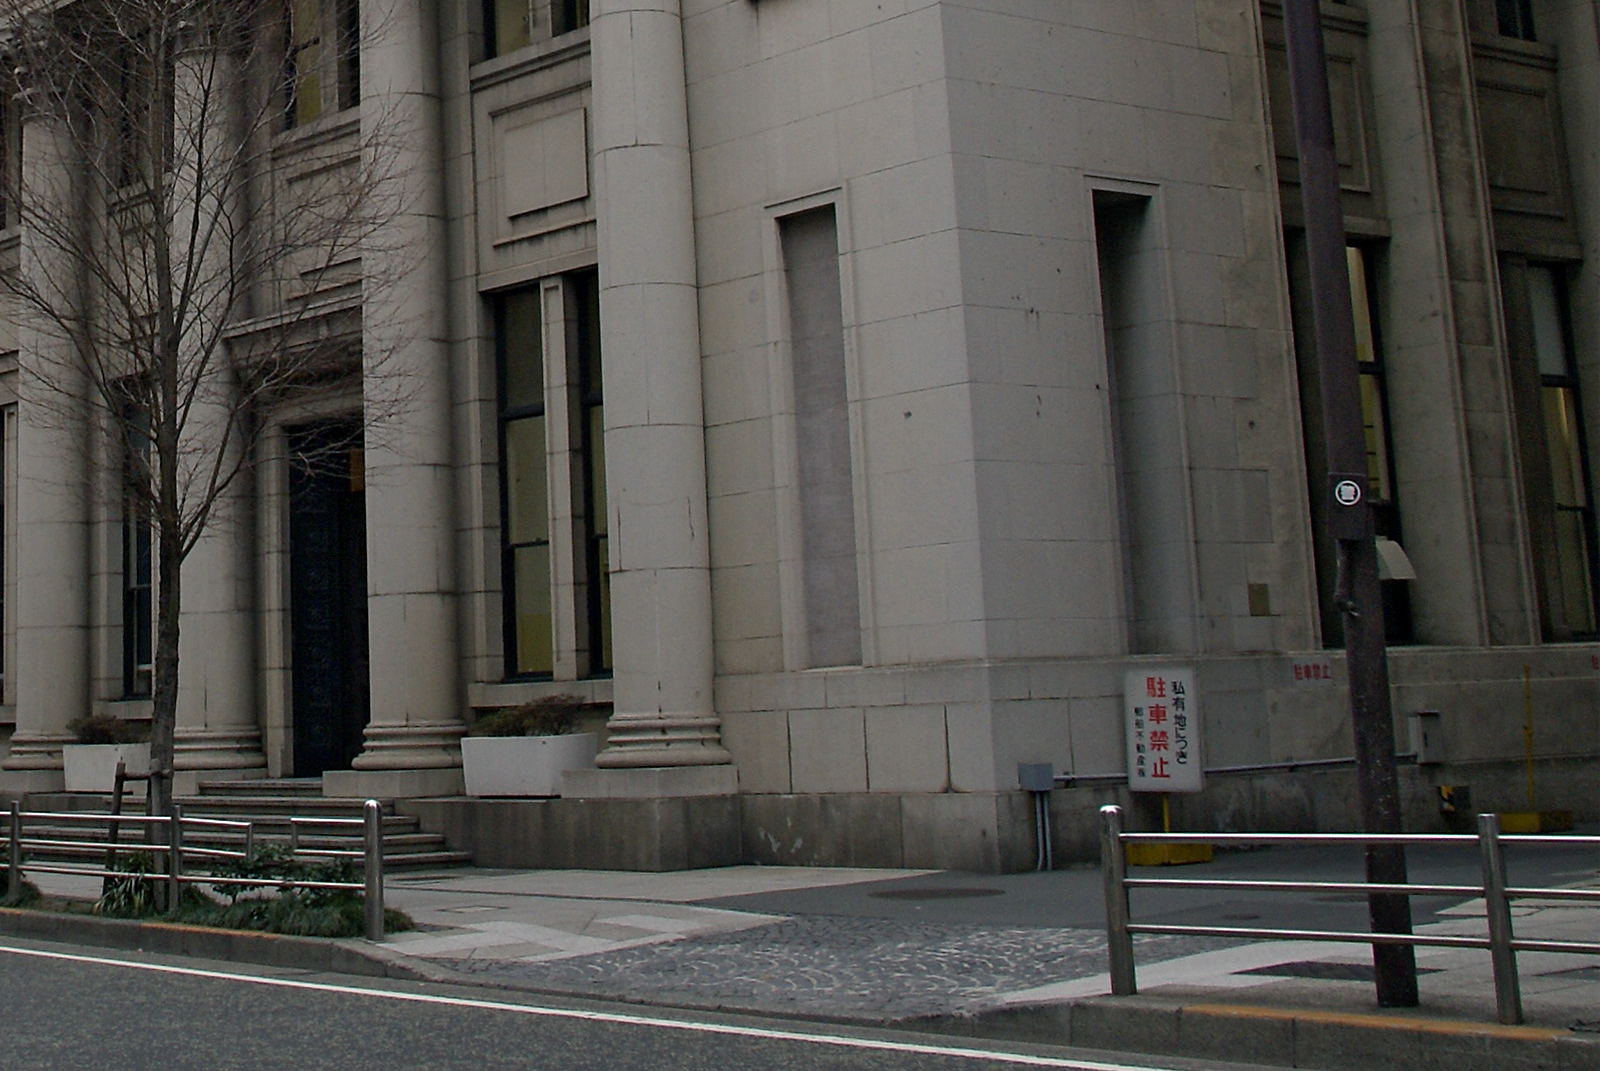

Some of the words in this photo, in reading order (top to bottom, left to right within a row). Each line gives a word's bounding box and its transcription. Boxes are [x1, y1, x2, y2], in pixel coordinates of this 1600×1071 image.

[1146, 677, 1170, 778] 駐車禁止
[1171, 681, 1188, 764] 私有地につき
